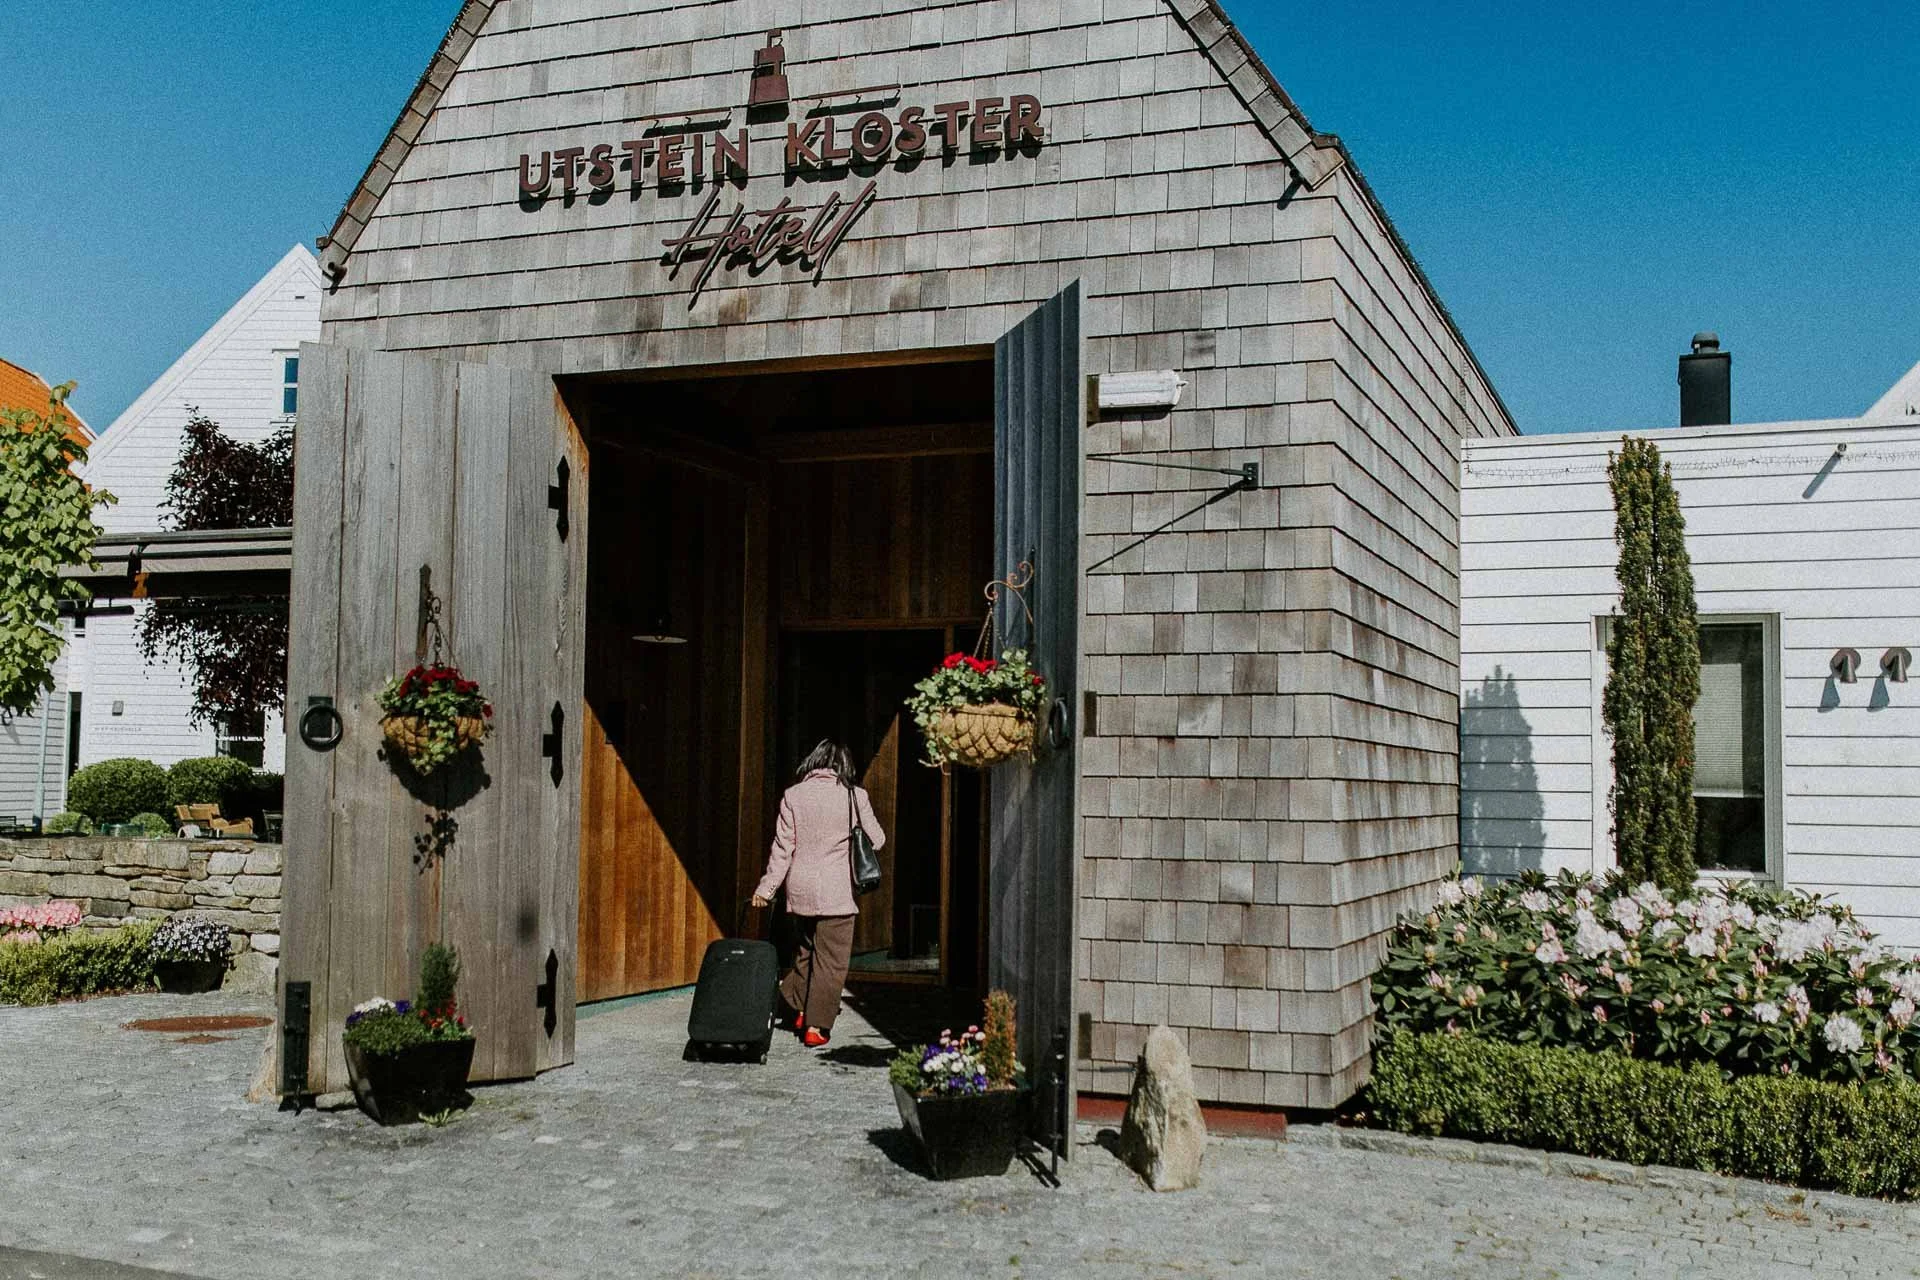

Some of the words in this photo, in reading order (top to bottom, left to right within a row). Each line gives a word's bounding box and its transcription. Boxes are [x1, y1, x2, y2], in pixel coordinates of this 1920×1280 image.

[519, 128, 749, 193] UTSTEIN
[787, 94, 1045, 166] KLOSTER
[661, 180, 878, 292] Hotell
